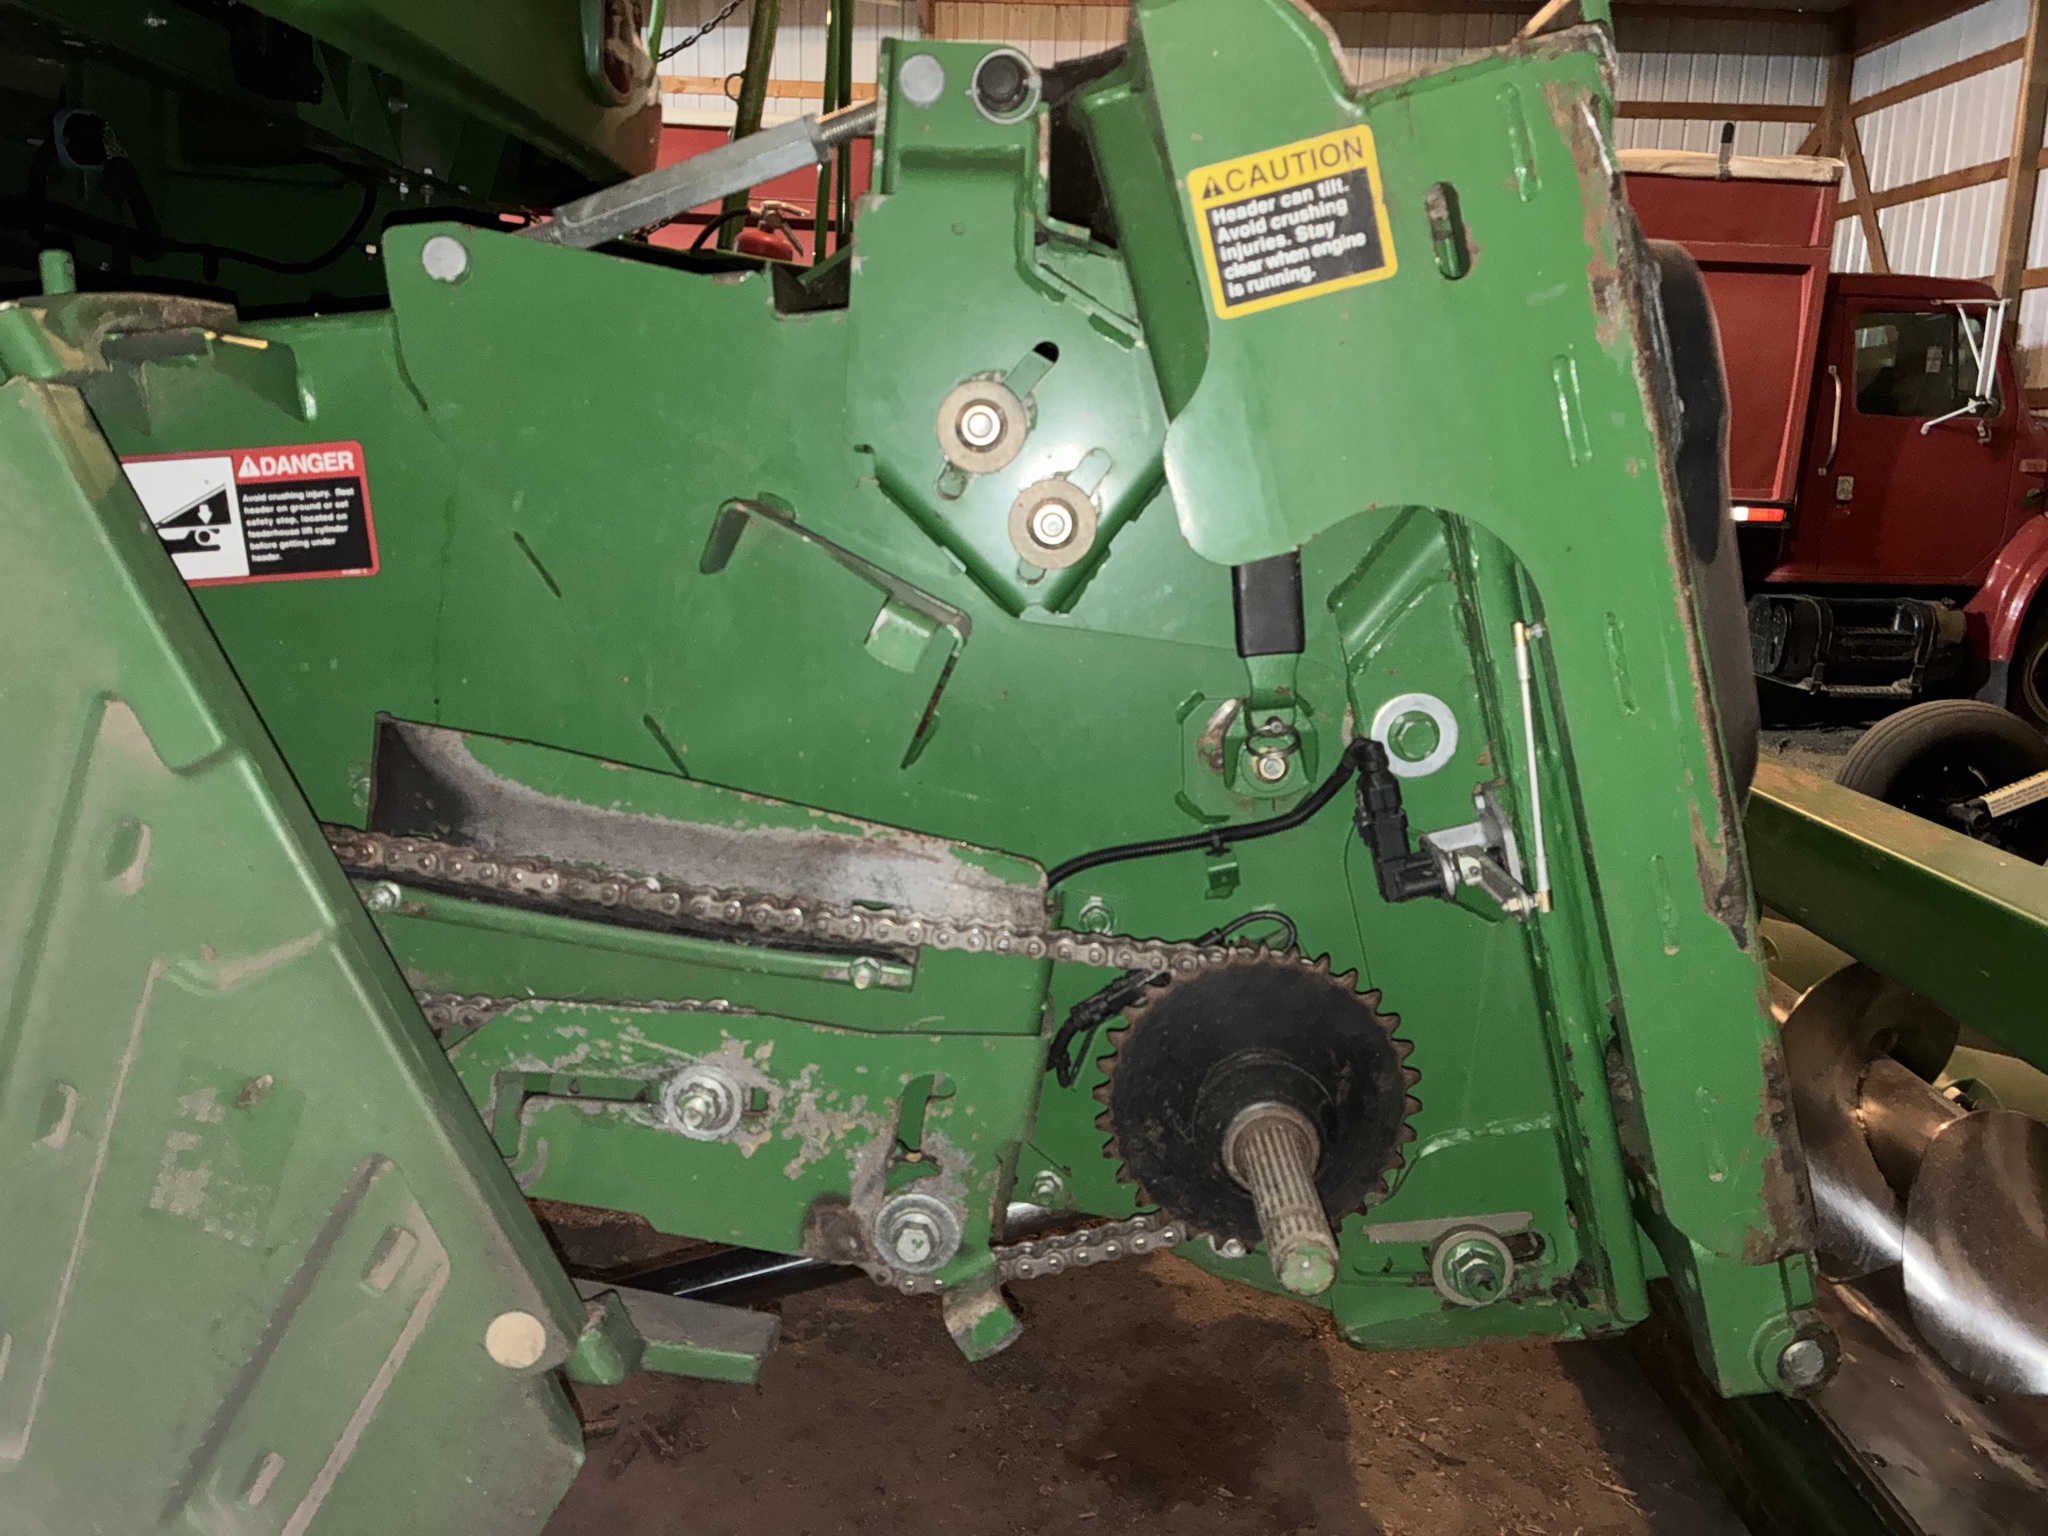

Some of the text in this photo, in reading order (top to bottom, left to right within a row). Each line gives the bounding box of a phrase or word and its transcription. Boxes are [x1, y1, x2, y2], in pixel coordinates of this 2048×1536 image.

[1225, 136, 1364, 192] CAUTION
[1212, 177, 1350, 226] Header can tilt.
[1217, 198, 1349, 244] Avoid crushing
[1219, 220, 1336, 262] injuries. Stay
[1223, 231, 1367, 280] clear when engine
[1226, 265, 1317, 299] is running.
[260, 451, 355, 476] DANGER
[242, 493, 267, 503] Avoid
[267, 491, 305, 501] crushing
[305, 489, 332, 499] injury.
[243, 505, 274, 515] header
[275, 504, 288, 513] on
[289, 501, 322, 514] ground
[322, 501, 333, 510] or
[300, 526, 313, 535] lift
[314, 524, 349, 535] cylinder
[335, 512, 348, 521] on
[249, 537, 336, 551] before getting under
